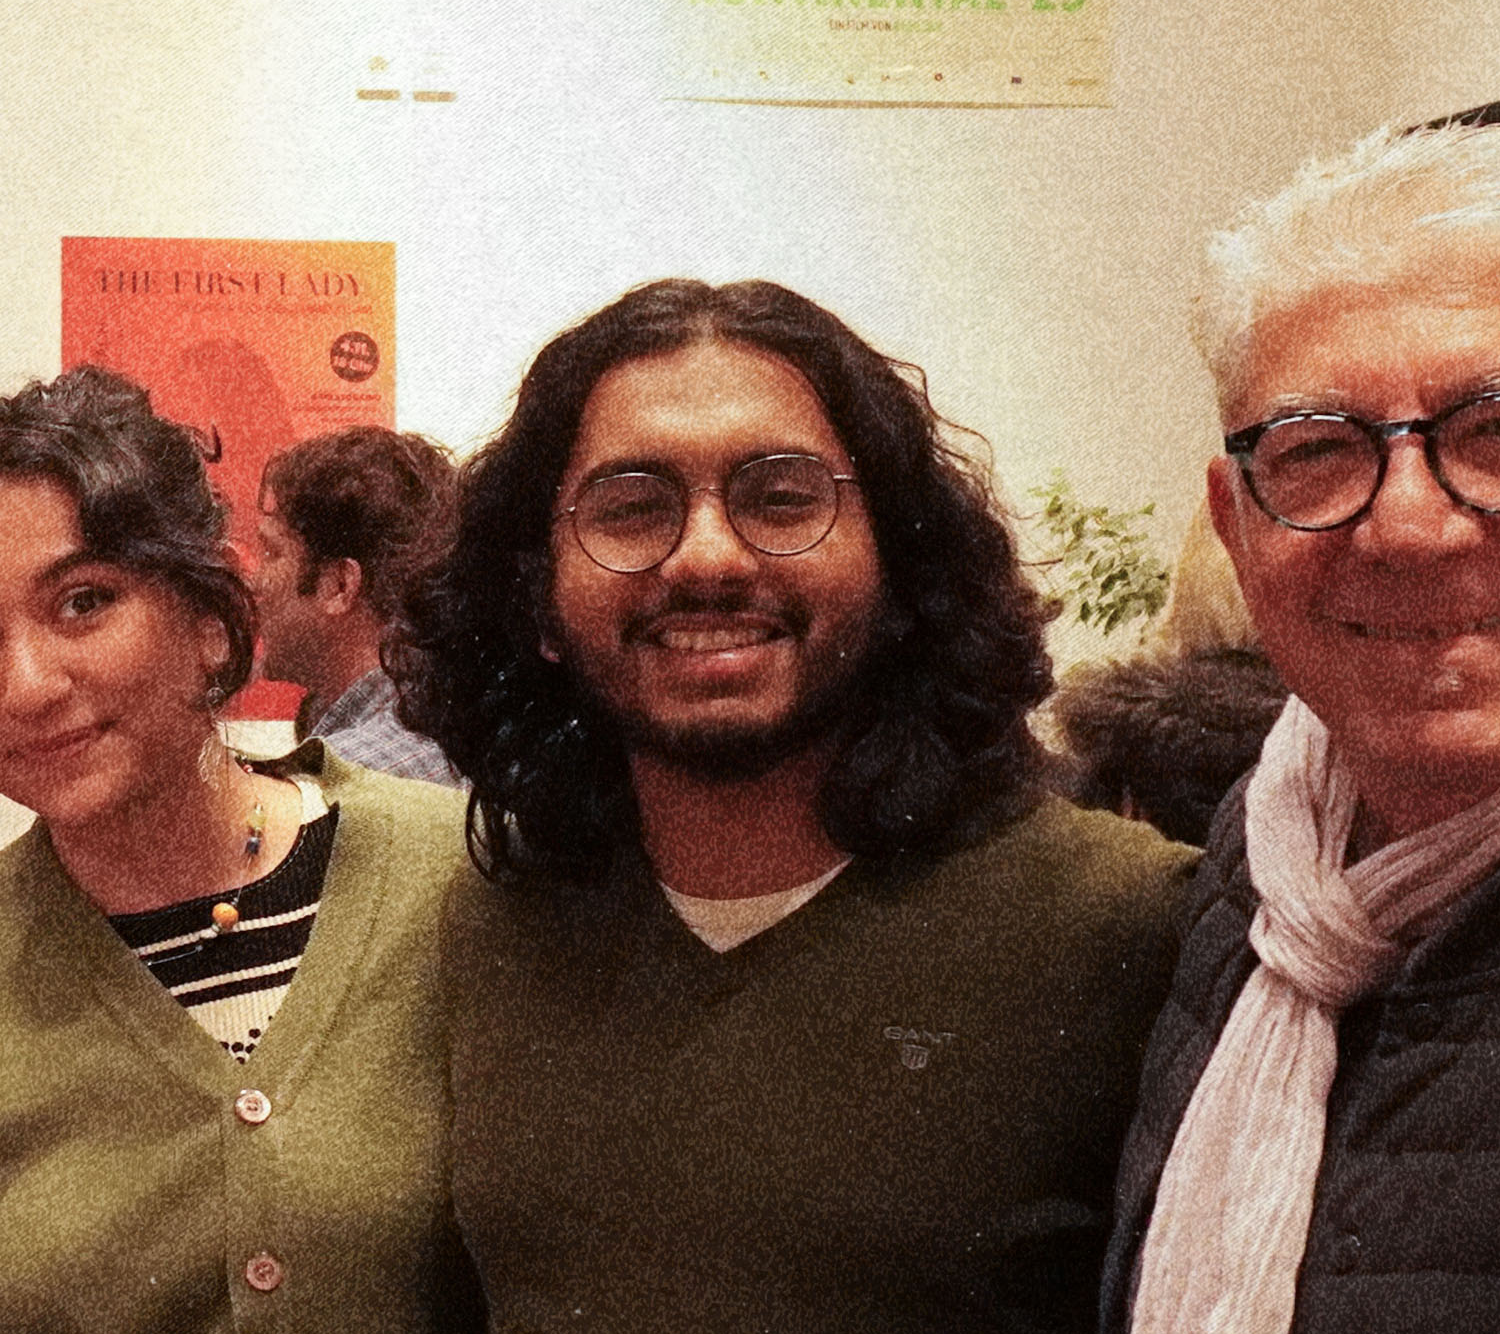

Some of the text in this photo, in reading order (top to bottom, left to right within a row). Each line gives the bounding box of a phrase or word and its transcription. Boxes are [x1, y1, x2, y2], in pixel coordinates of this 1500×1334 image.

[97, 269, 365, 297] THE FIRST LADY
